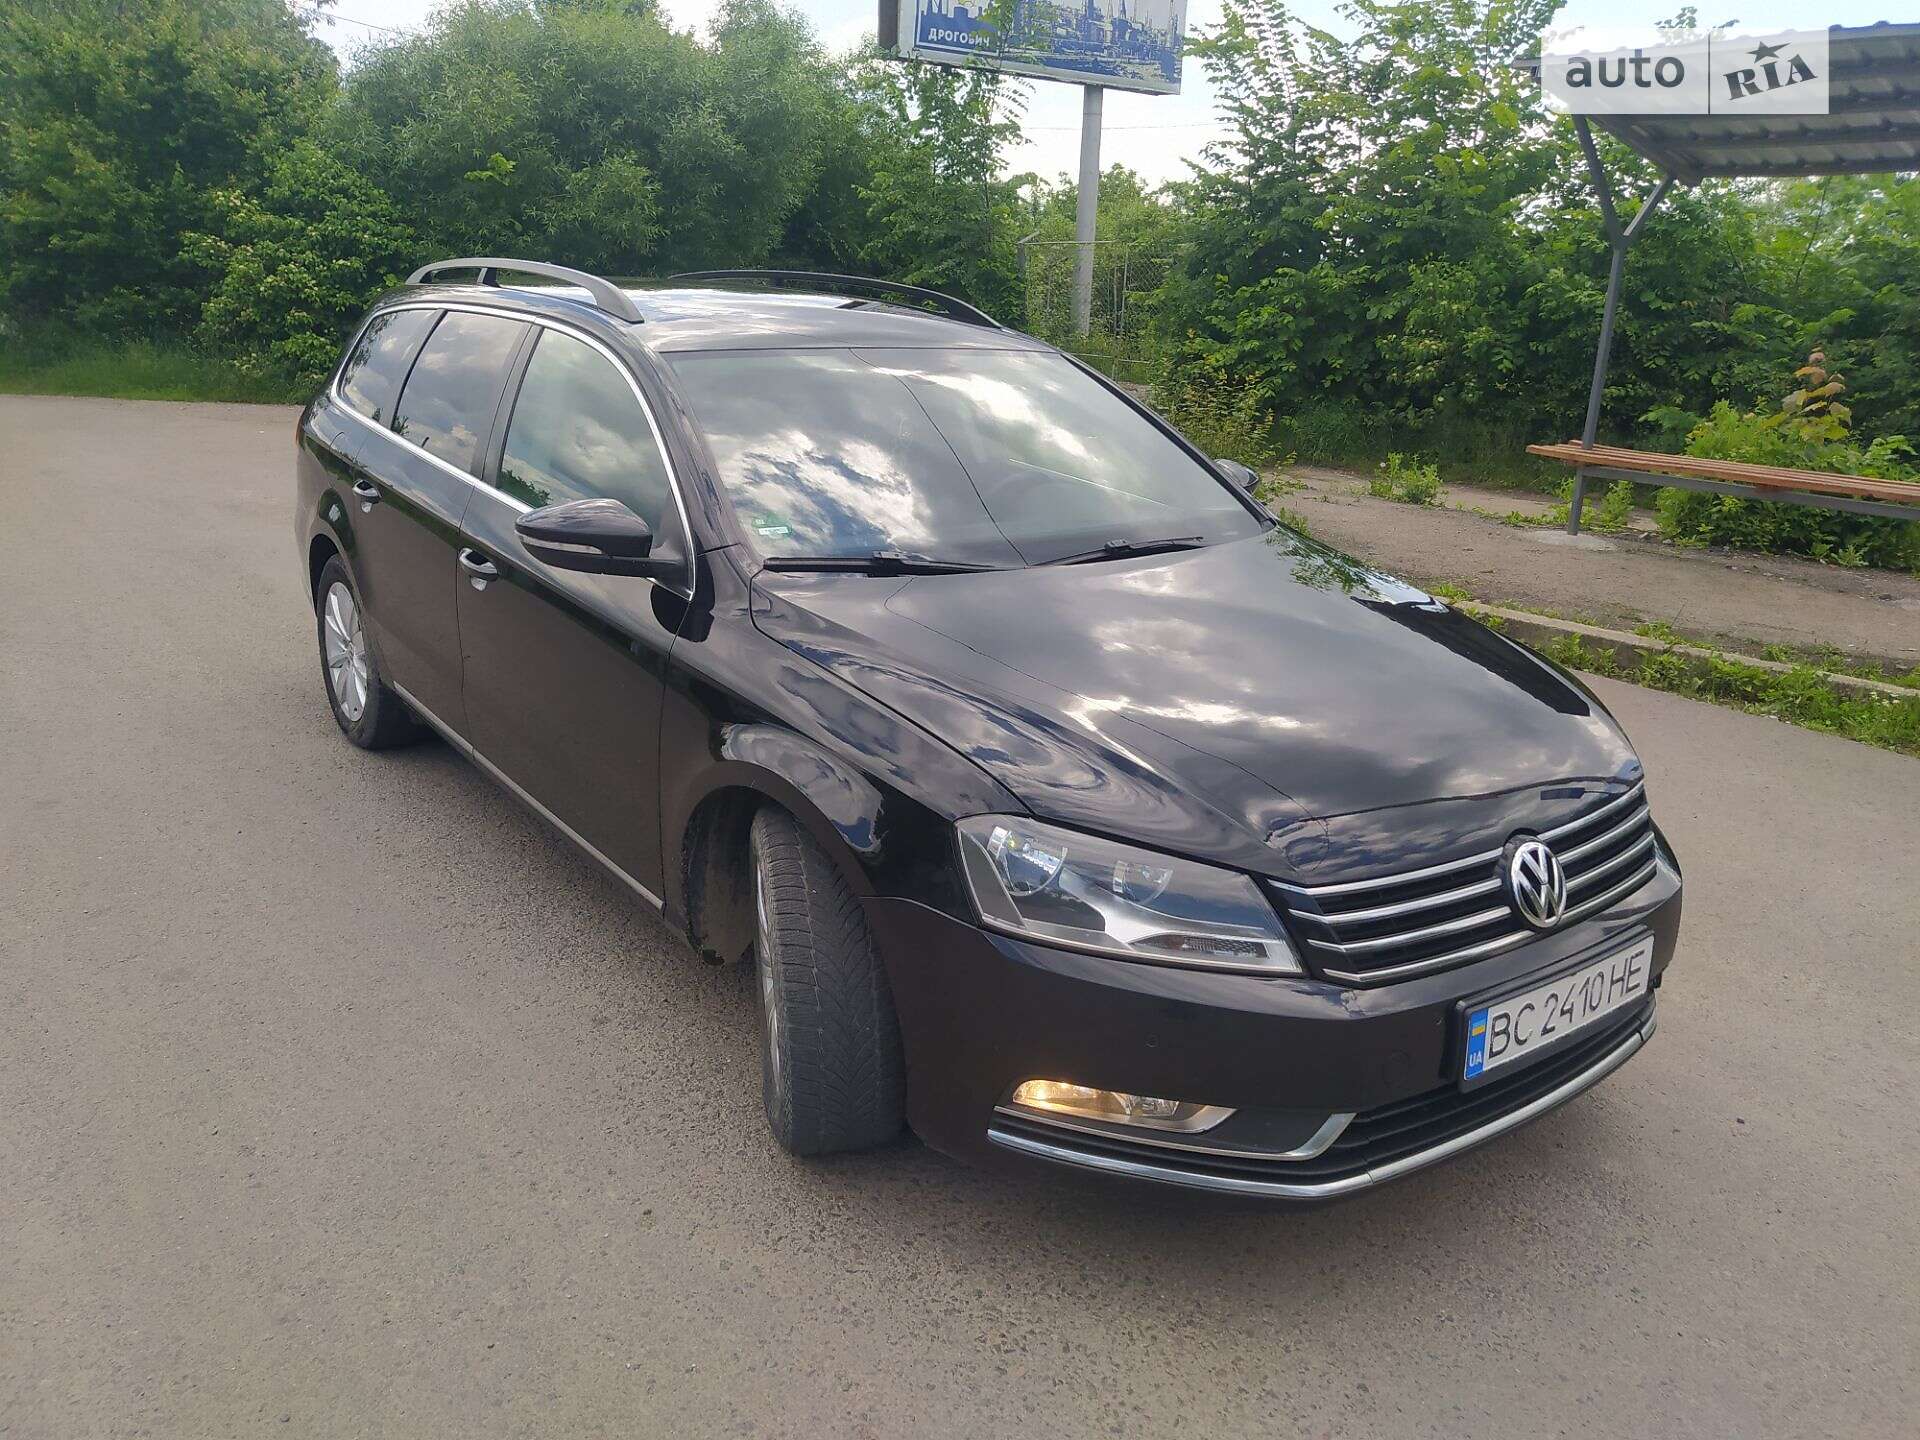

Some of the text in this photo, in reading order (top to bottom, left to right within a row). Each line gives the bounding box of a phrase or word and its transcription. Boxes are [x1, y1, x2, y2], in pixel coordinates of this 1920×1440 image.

[1488, 949, 1645, 1060] BC 2410 HE
[1469, 1050, 1482, 1067] UA
